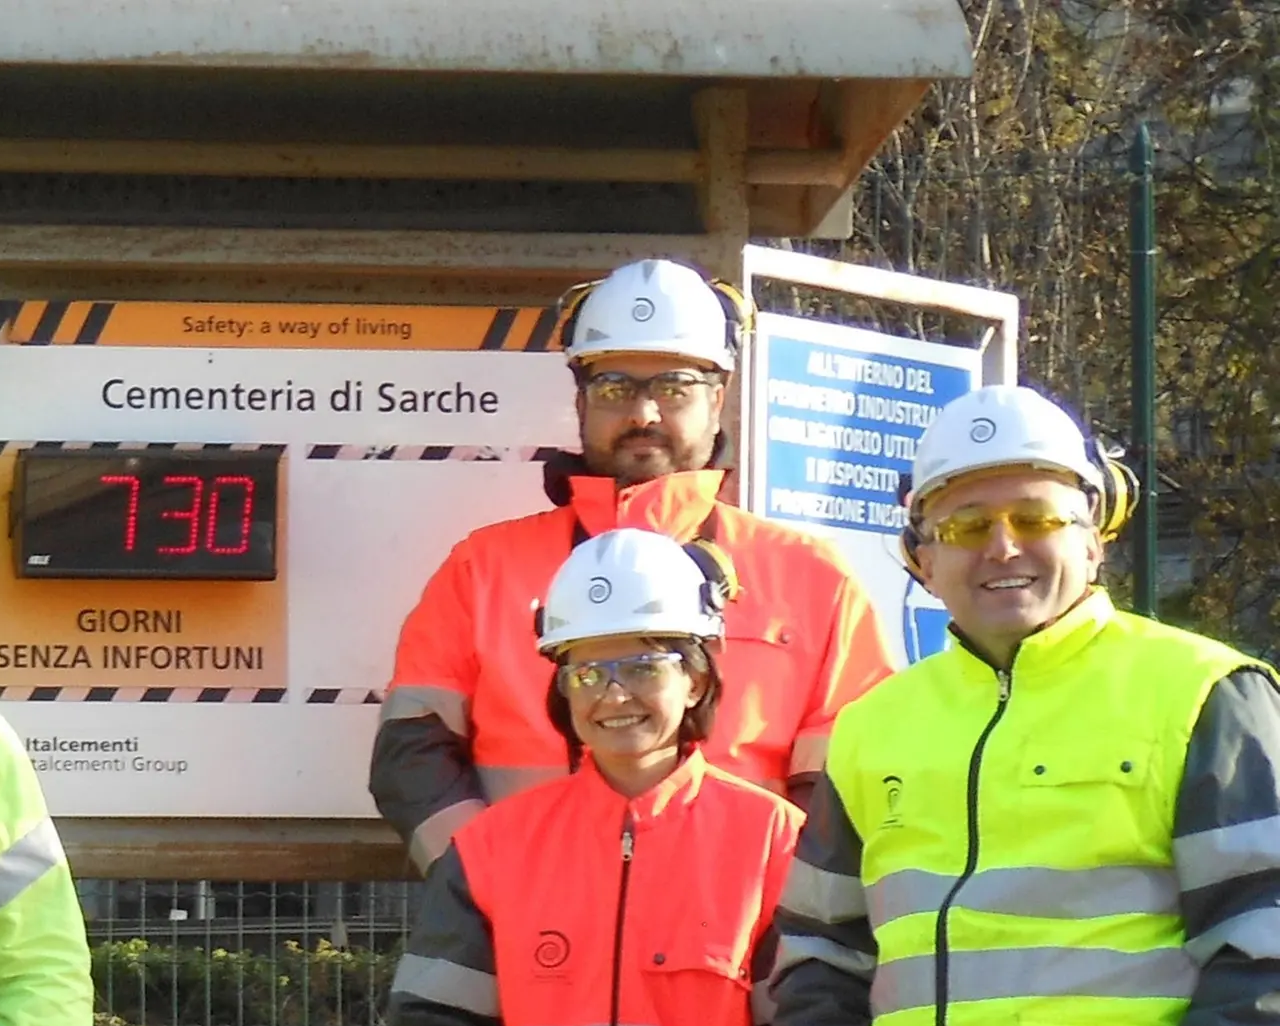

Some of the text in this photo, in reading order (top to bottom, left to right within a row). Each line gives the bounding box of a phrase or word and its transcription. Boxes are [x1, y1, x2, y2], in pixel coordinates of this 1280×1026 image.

[182, 315, 413, 340] Safety: a way of living
[905, 367, 935, 395] DEL
[101, 378, 500, 414] Cementeria di Sarche
[857, 394, 945, 428] INDUSTRIA
[883, 434, 922, 460] UTIL
[99, 474, 255, 554] 730
[76, 608, 182, 634] GIORNI
[102, 645, 265, 671] INFORTUNI
[25, 736, 140, 753] Italcementi
[31, 756, 189, 775] talcementi Group
